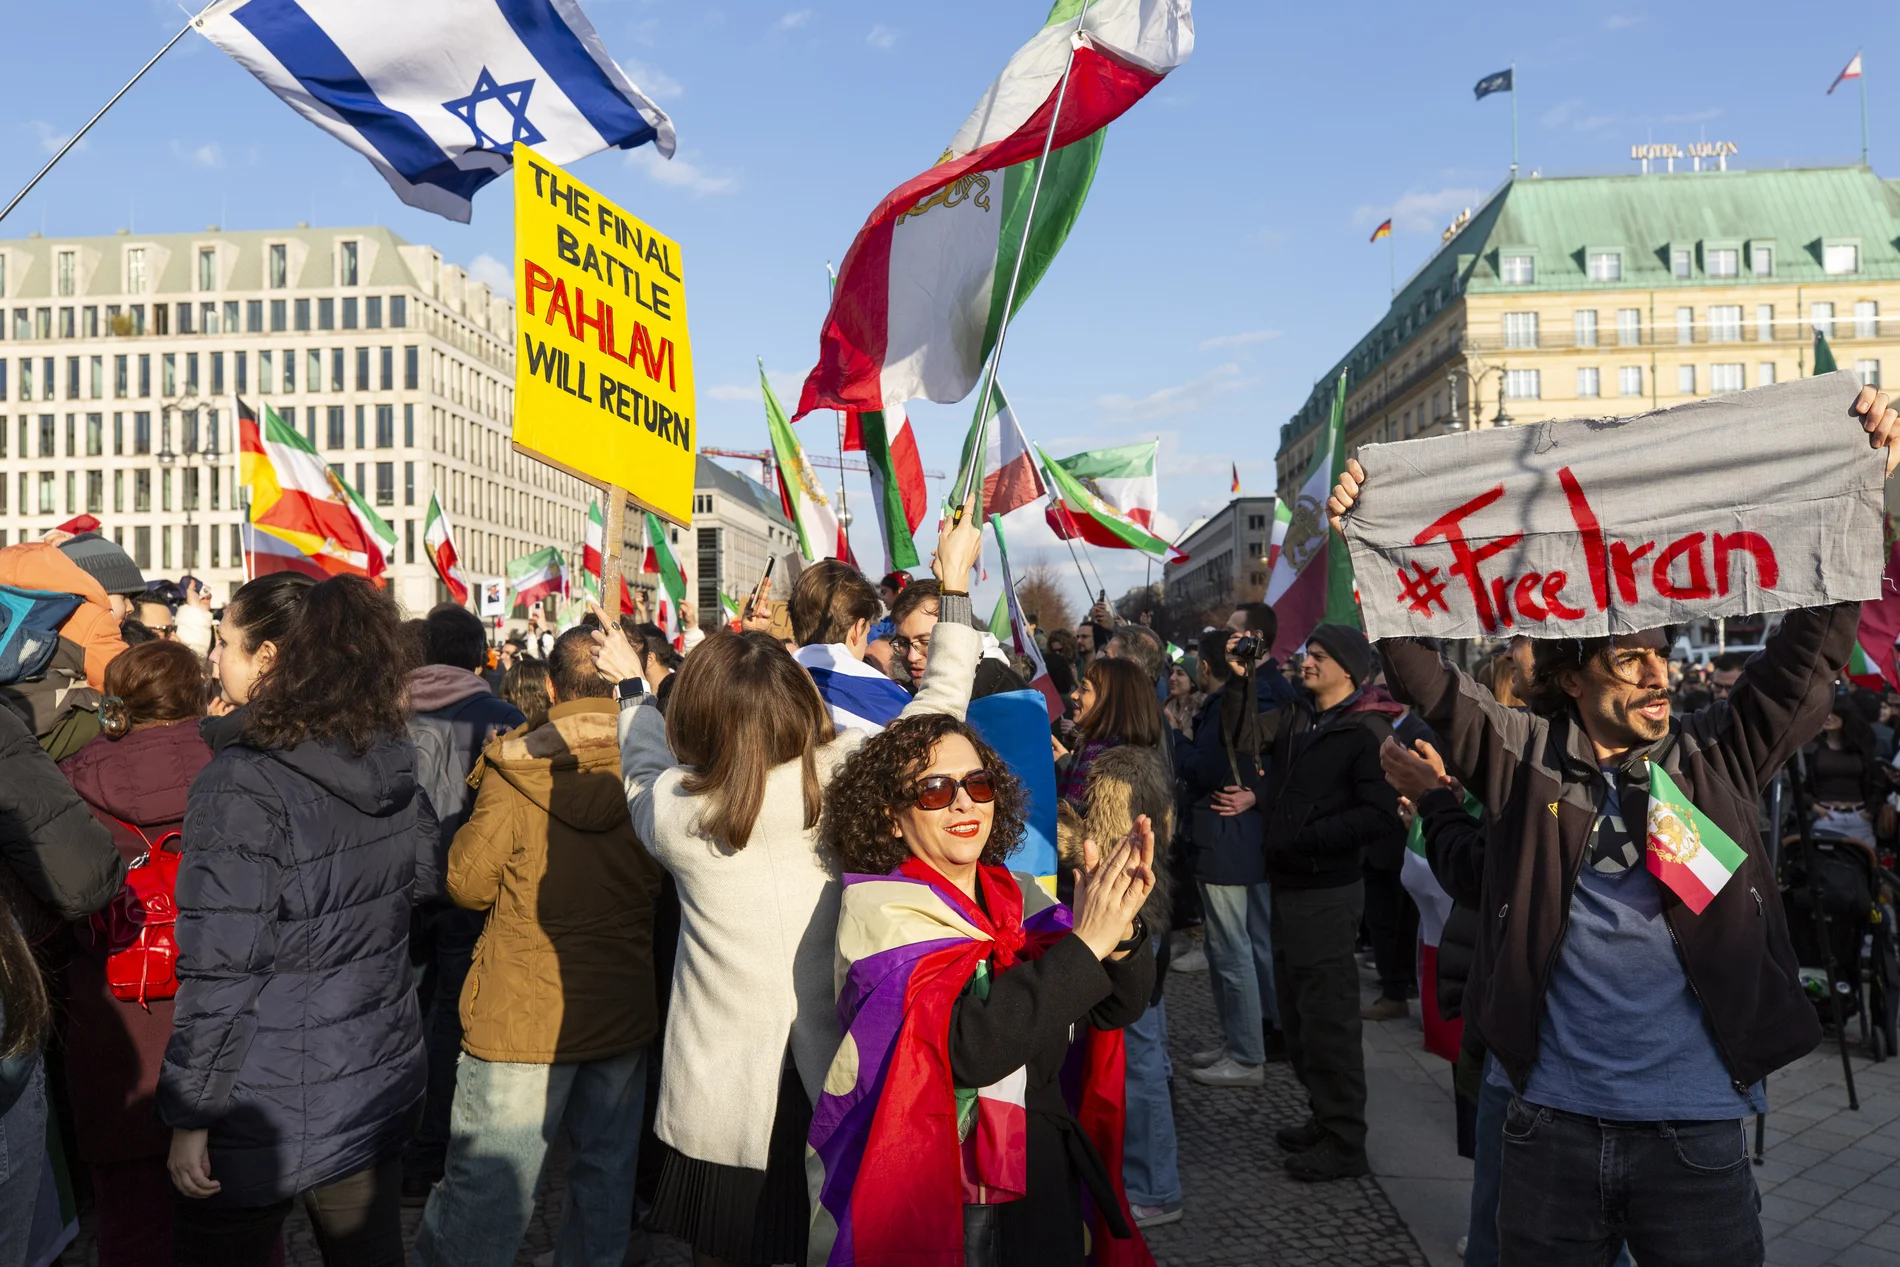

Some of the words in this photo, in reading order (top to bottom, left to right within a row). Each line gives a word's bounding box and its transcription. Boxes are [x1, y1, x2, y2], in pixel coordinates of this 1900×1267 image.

[1631, 144, 1679, 159] HOTEL
[1687, 141, 1738, 157] ADLON
[528, 160, 590, 227] THE
[598, 203, 681, 283] FINAL
[557, 223, 671, 321] BATTLE
[525, 258, 676, 392] PAHLAVI
[525, 332, 592, 403] WILL
[600, 372, 690, 452] RETURN
